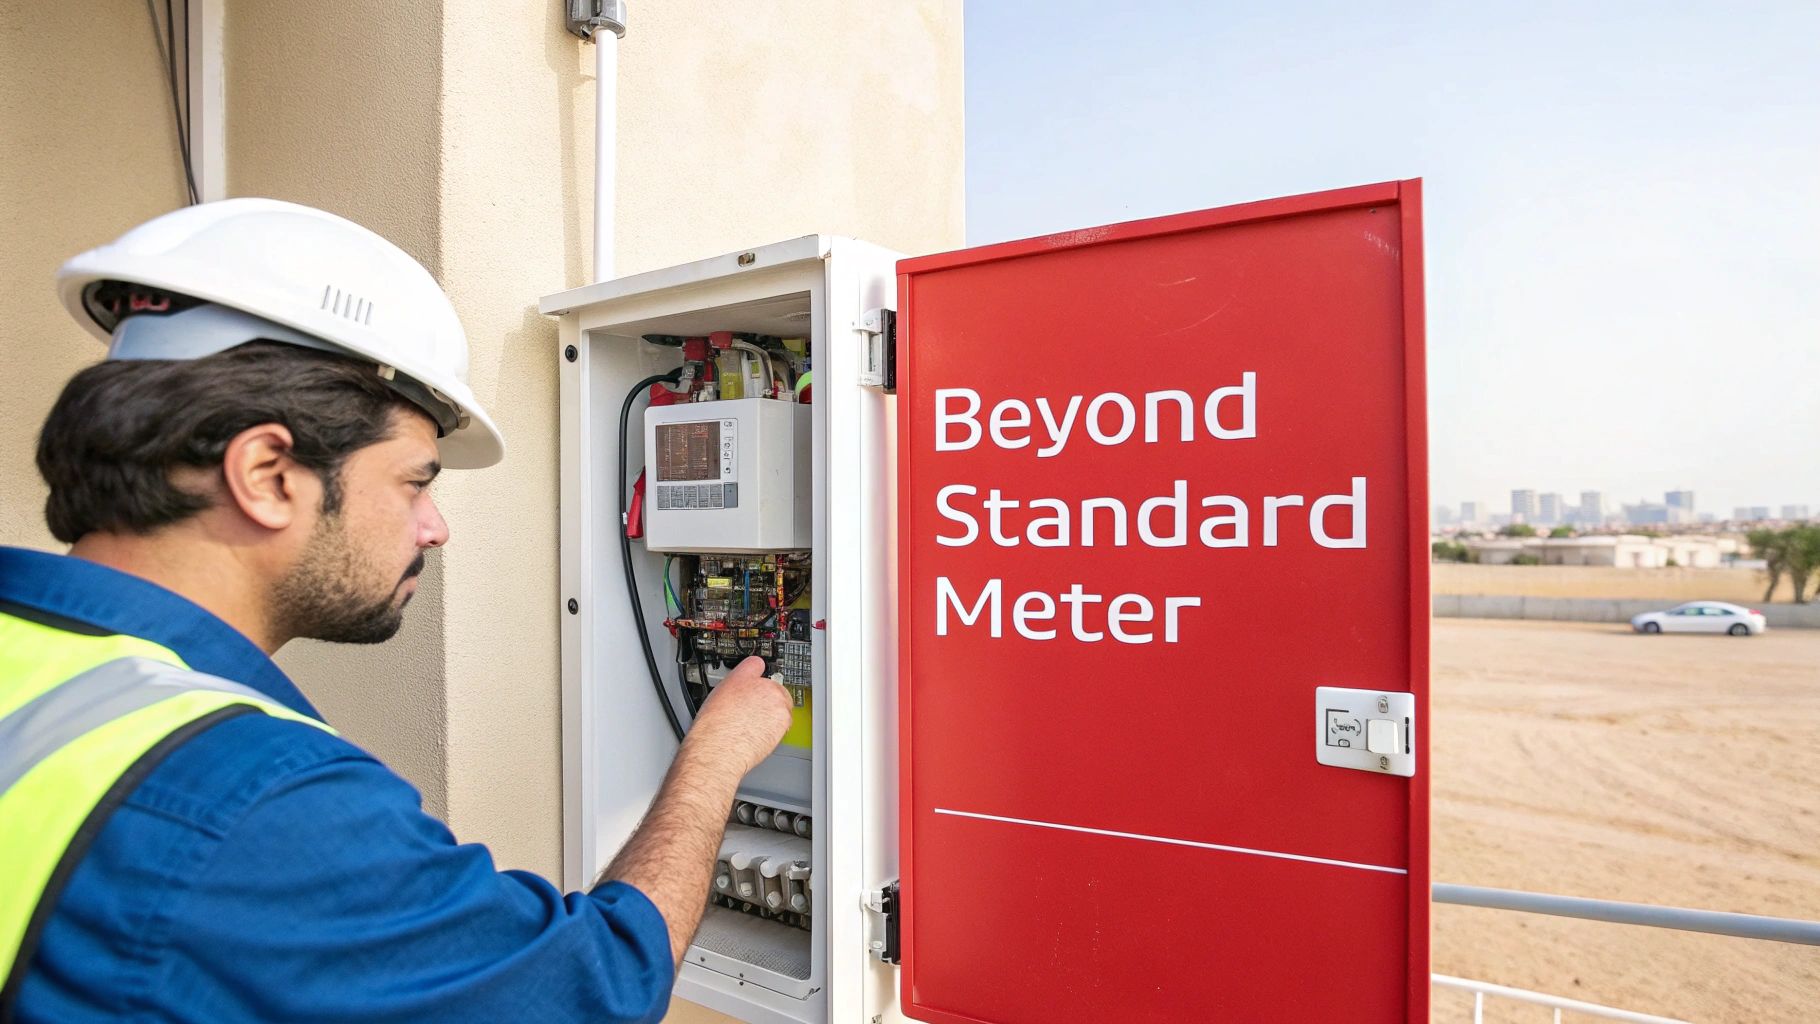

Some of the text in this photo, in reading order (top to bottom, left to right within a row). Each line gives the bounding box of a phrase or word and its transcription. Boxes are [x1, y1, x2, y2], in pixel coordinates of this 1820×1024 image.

[935, 371, 1257, 458] Beyond
[935, 476, 1367, 549] Standard
[935, 576, 1201, 644] Meter
